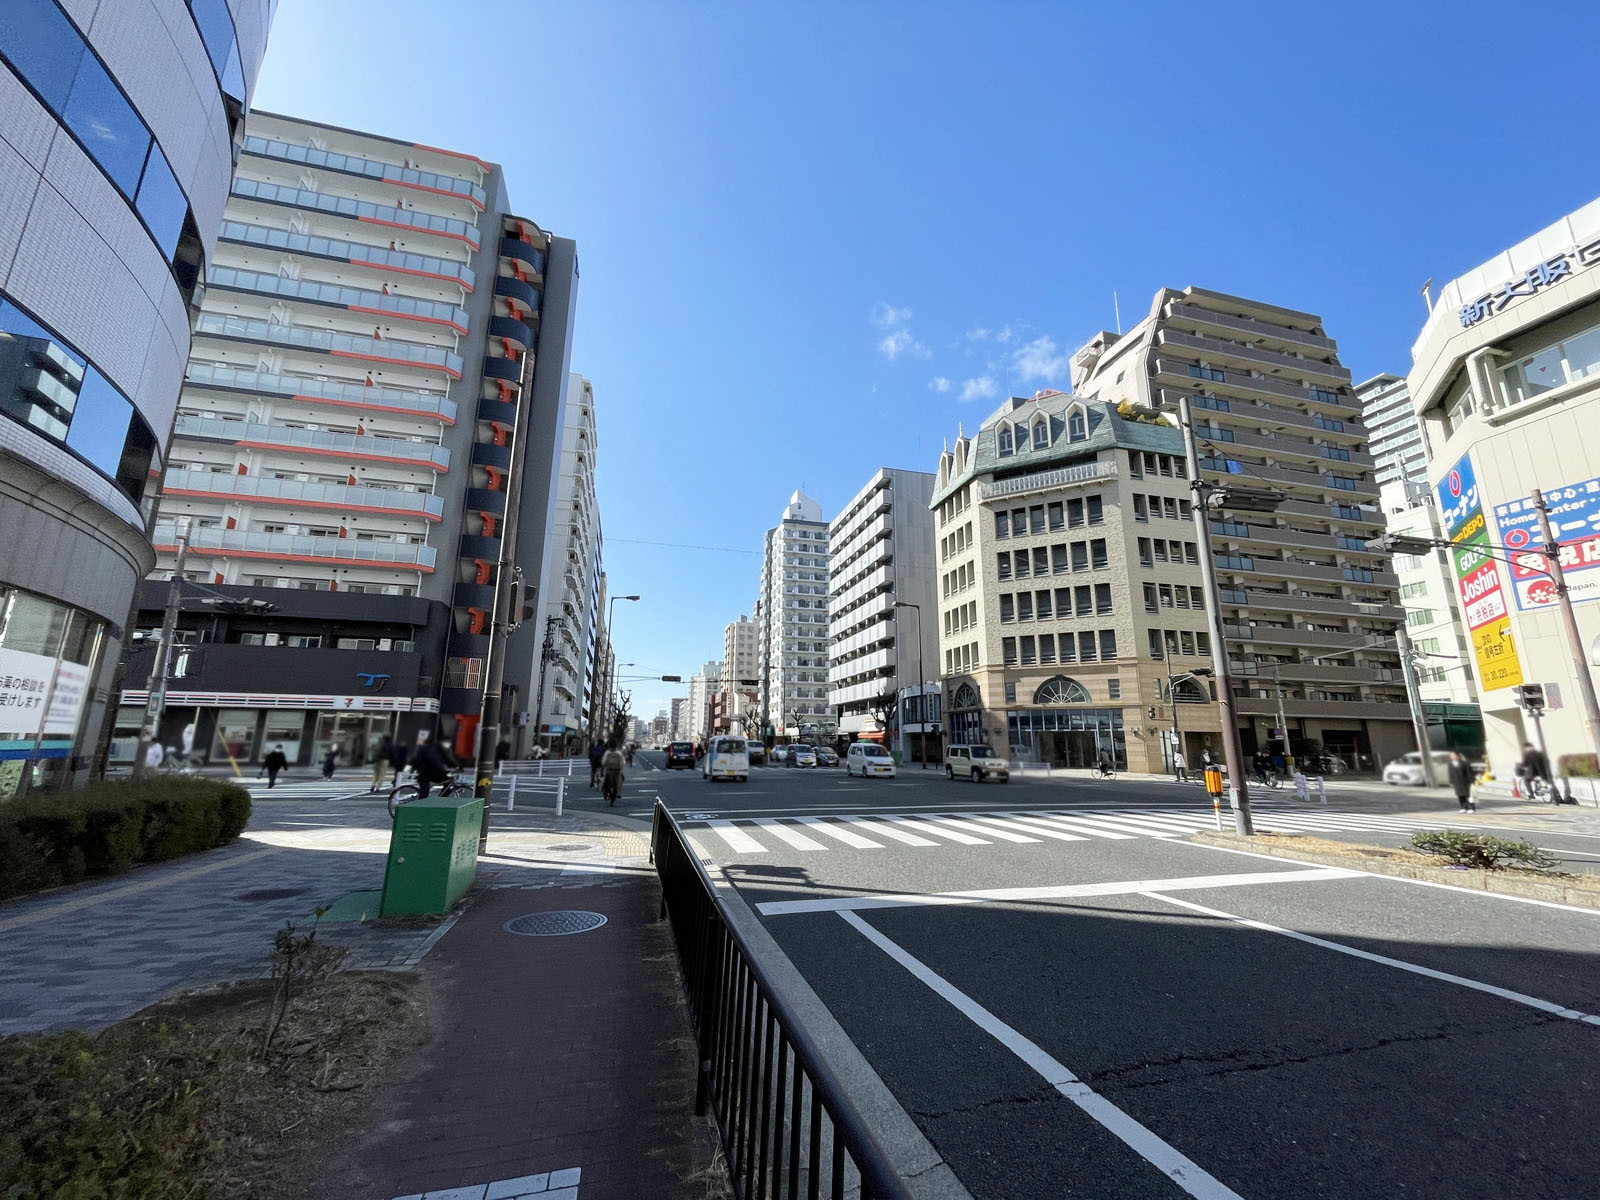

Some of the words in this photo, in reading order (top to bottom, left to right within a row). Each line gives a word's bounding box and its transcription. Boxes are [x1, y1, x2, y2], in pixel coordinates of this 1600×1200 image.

[1443, 484, 1479, 530] コーナン
[1499, 512, 1537, 528] Home
[1463, 567, 1498, 602] Joshin
